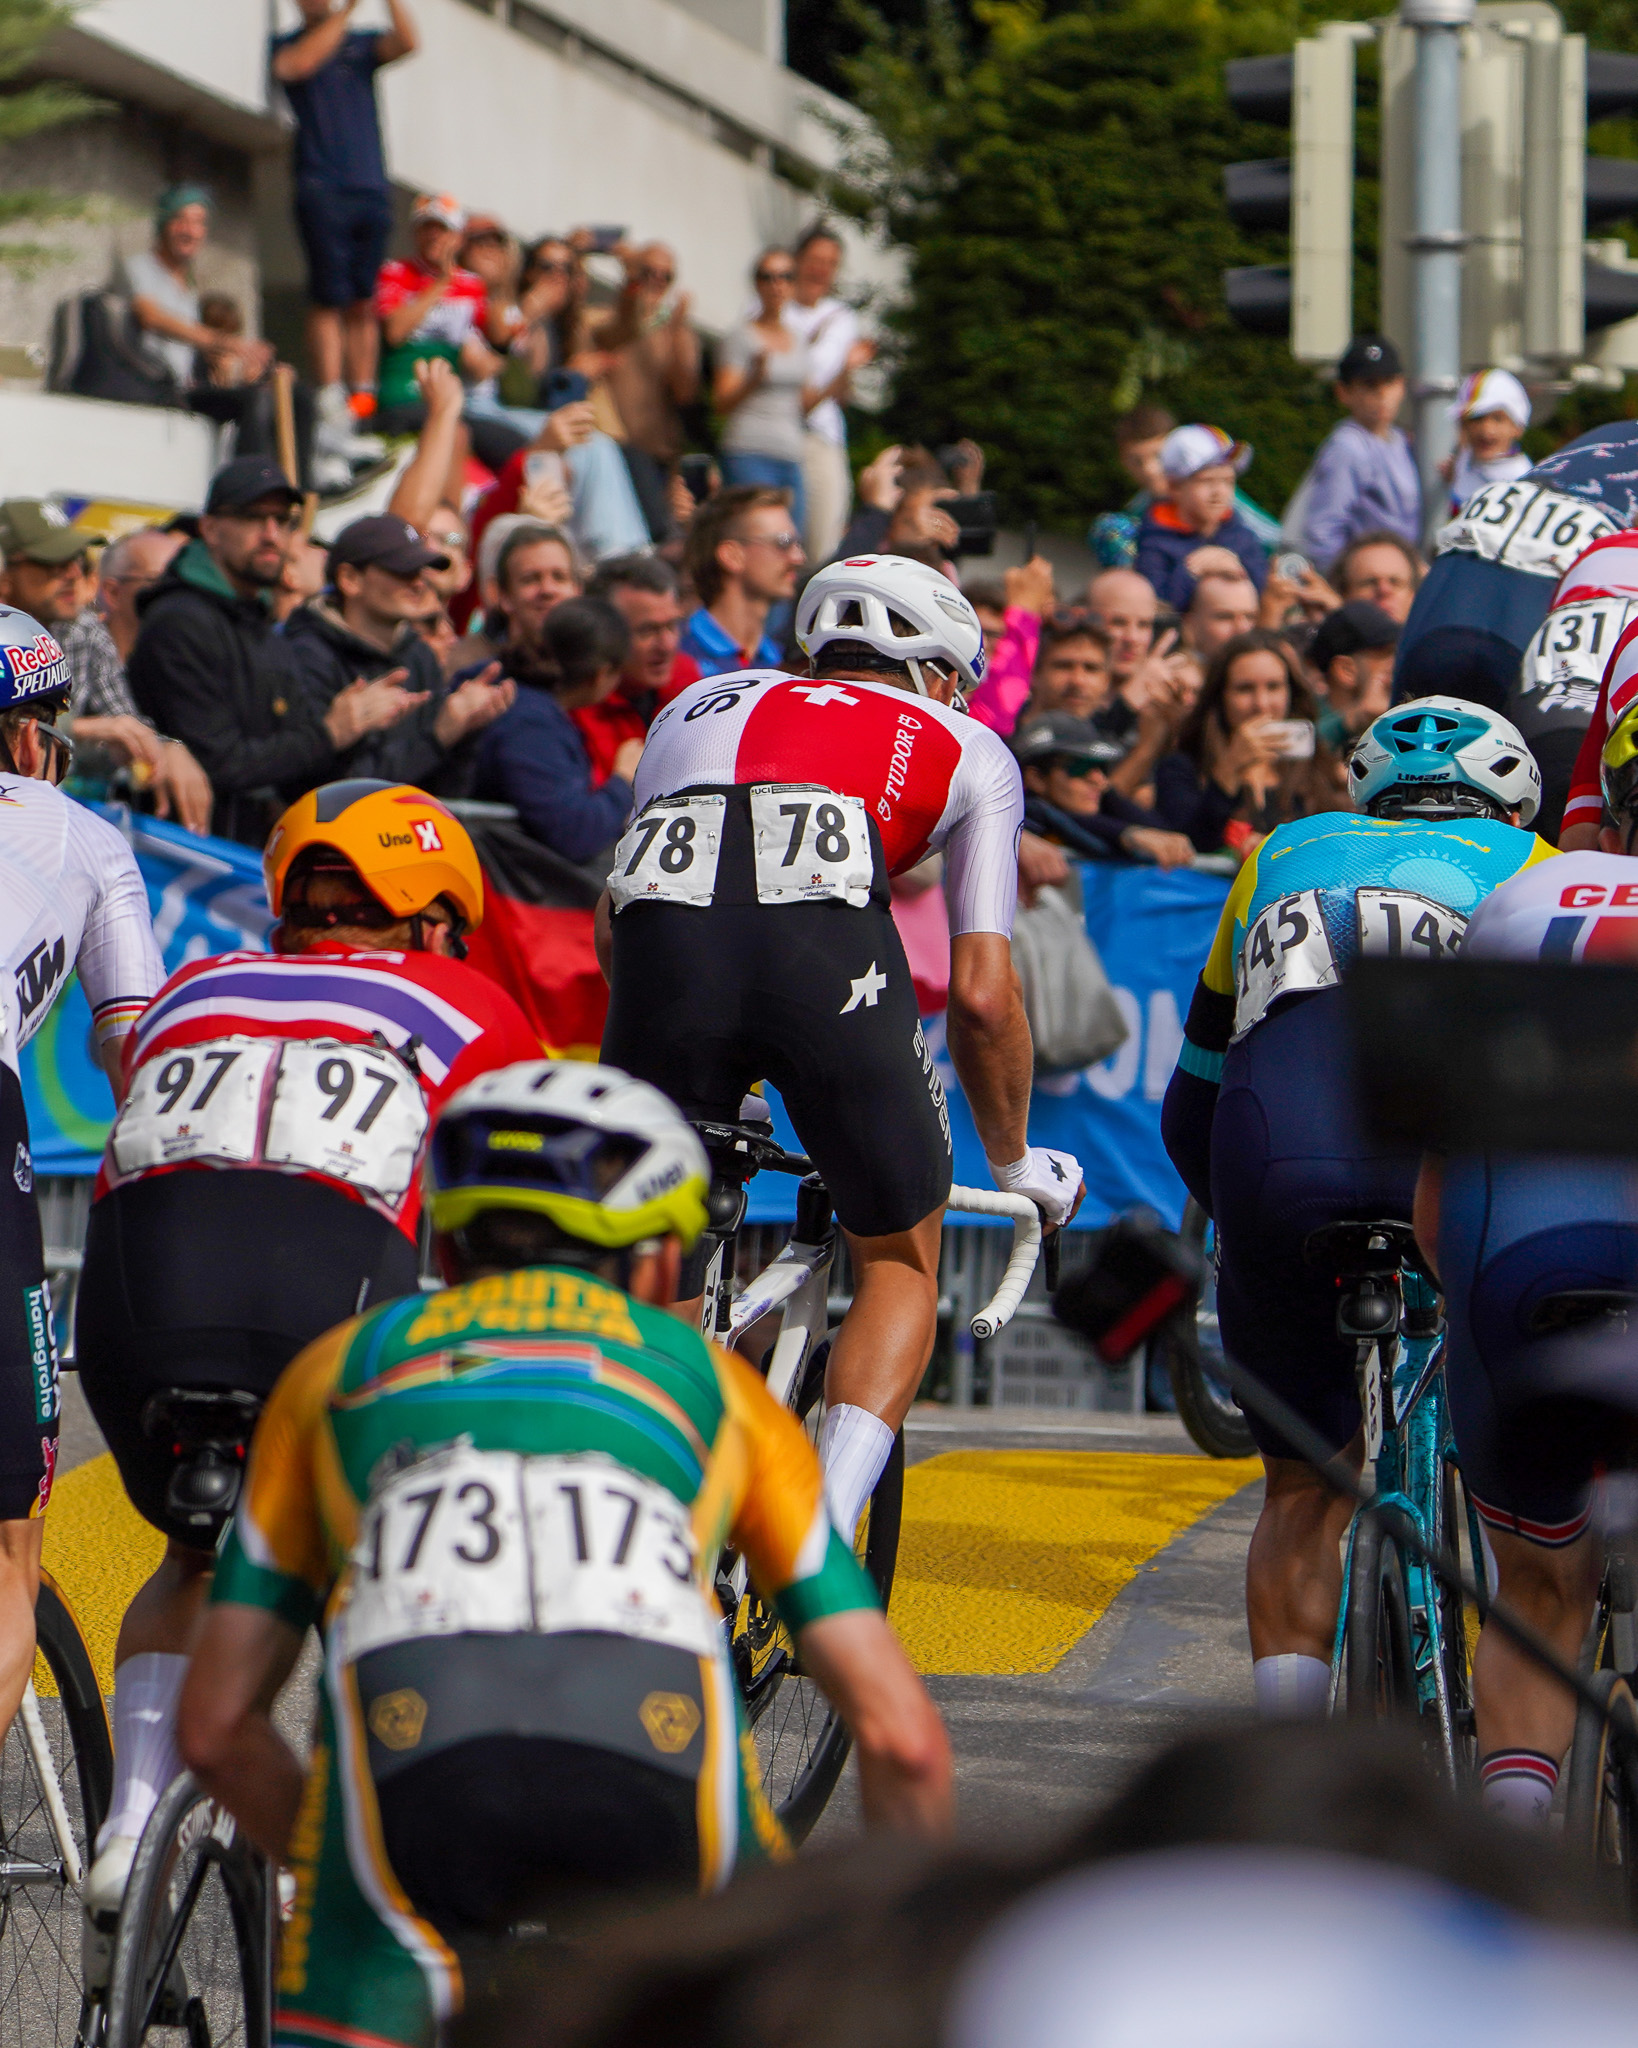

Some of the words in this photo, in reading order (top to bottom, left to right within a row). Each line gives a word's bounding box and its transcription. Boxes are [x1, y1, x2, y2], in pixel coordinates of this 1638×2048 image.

[4, 633, 51, 678] Red
[1538, 612, 1607, 657] 131
[755, 787, 771, 795] UCI
[885, 728, 916, 802] TUDOR
[624, 816, 697, 877] 78
[779, 803, 851, 868] 78
[14, 933, 65, 1036] KTM
[157, 1050, 242, 1115] 97
[316, 1058, 398, 1133] 97
[29, 1289, 52, 1418] hansgrohe
[367, 1482, 502, 1580] 173
